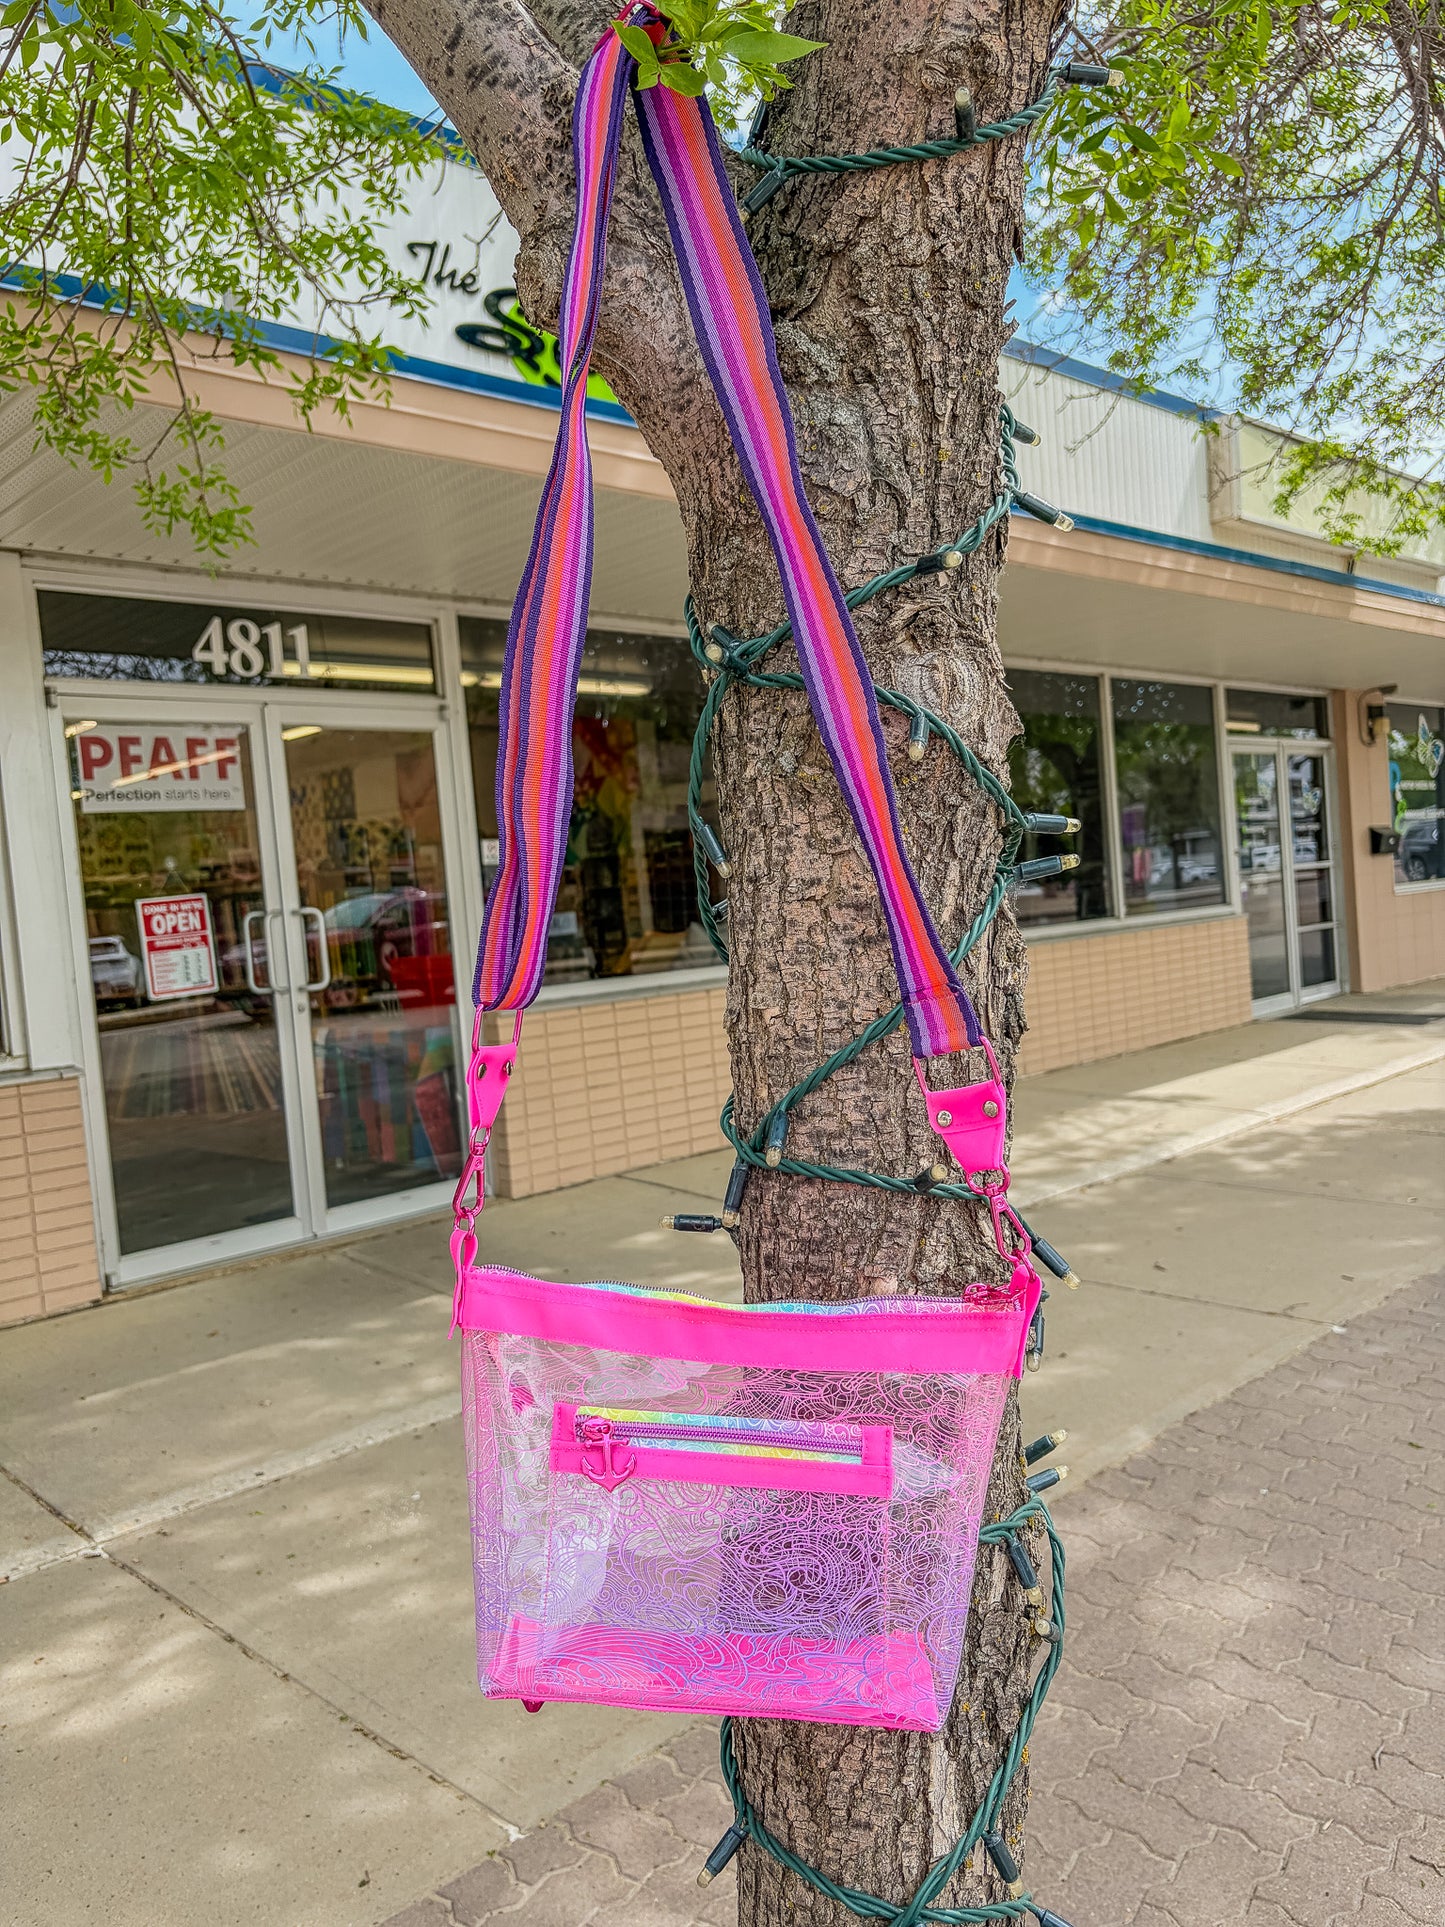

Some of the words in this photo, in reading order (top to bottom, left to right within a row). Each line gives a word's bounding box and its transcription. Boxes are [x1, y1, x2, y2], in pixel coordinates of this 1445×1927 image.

[407, 241, 480, 294] The
[192, 615, 315, 680] 4811
[79, 735, 238, 781] PFAFF
[85, 788, 161, 801] Perfection
[165, 788, 199, 799] starts
[150, 911, 203, 935] OPEN
